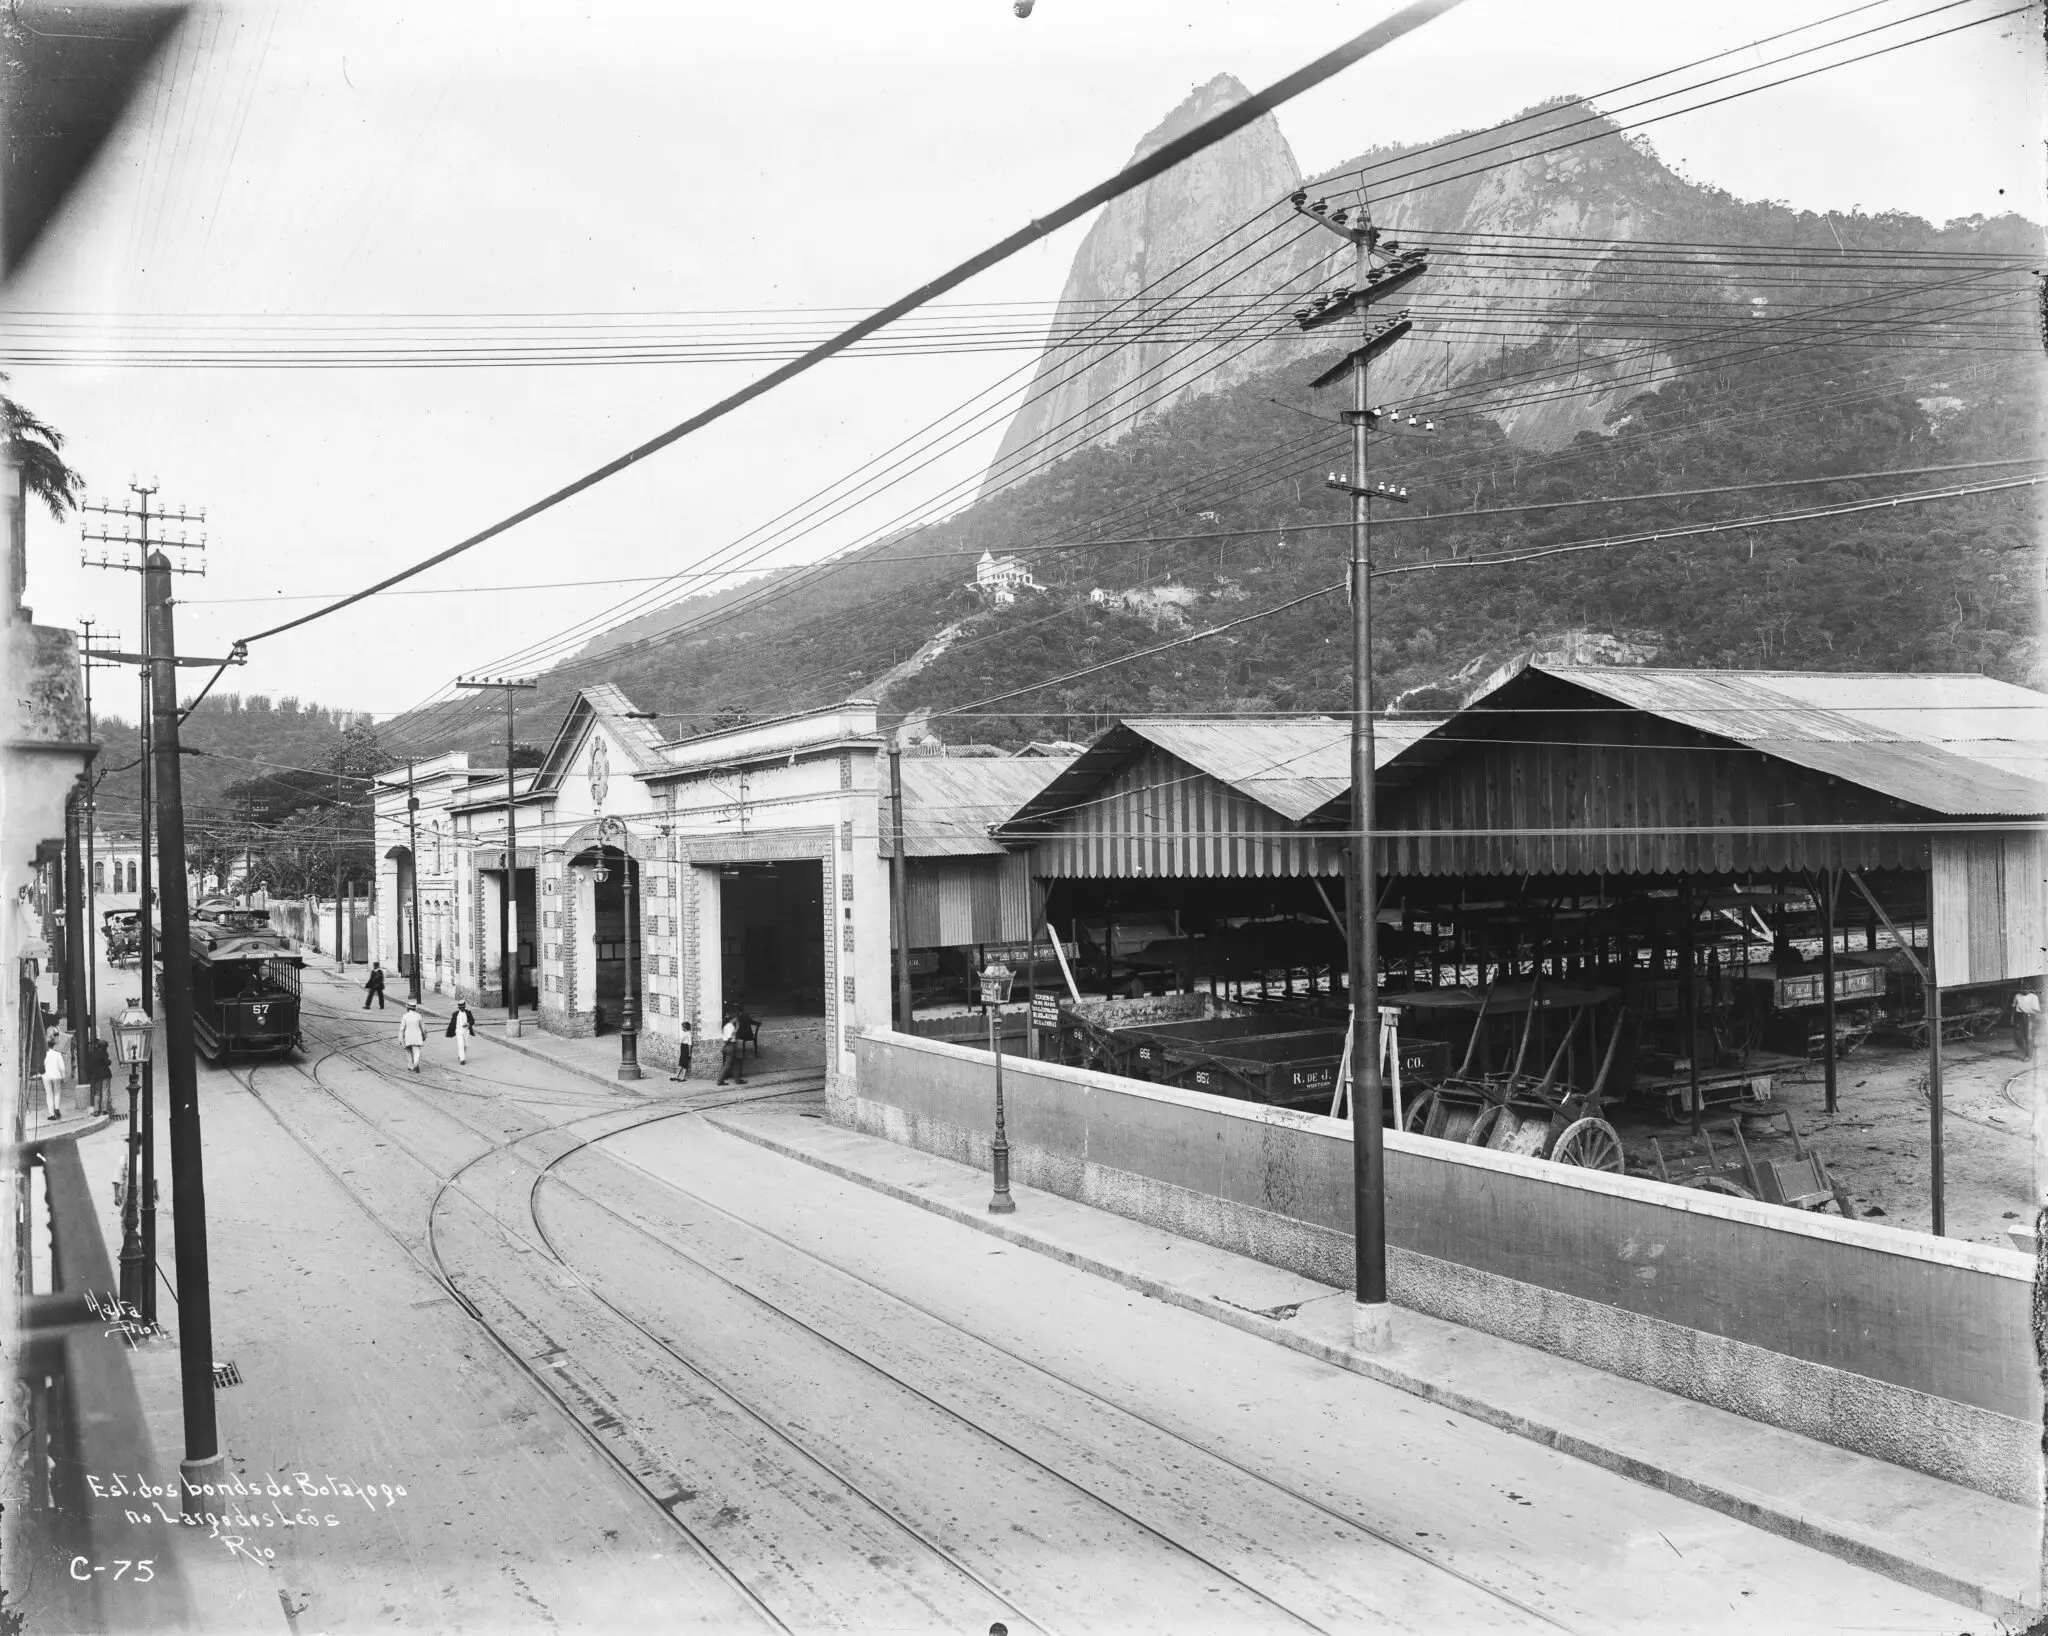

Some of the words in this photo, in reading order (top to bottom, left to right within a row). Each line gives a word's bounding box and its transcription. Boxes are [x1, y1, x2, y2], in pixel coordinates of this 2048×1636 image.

[252, 1004, 269, 1014] 57
[1293, 1072, 1305, 1085] R.
[1307, 1072, 1318, 1083] DE
[1321, 1069, 1332, 1081] J.
[1407, 1057, 1424, 1069] CO.
